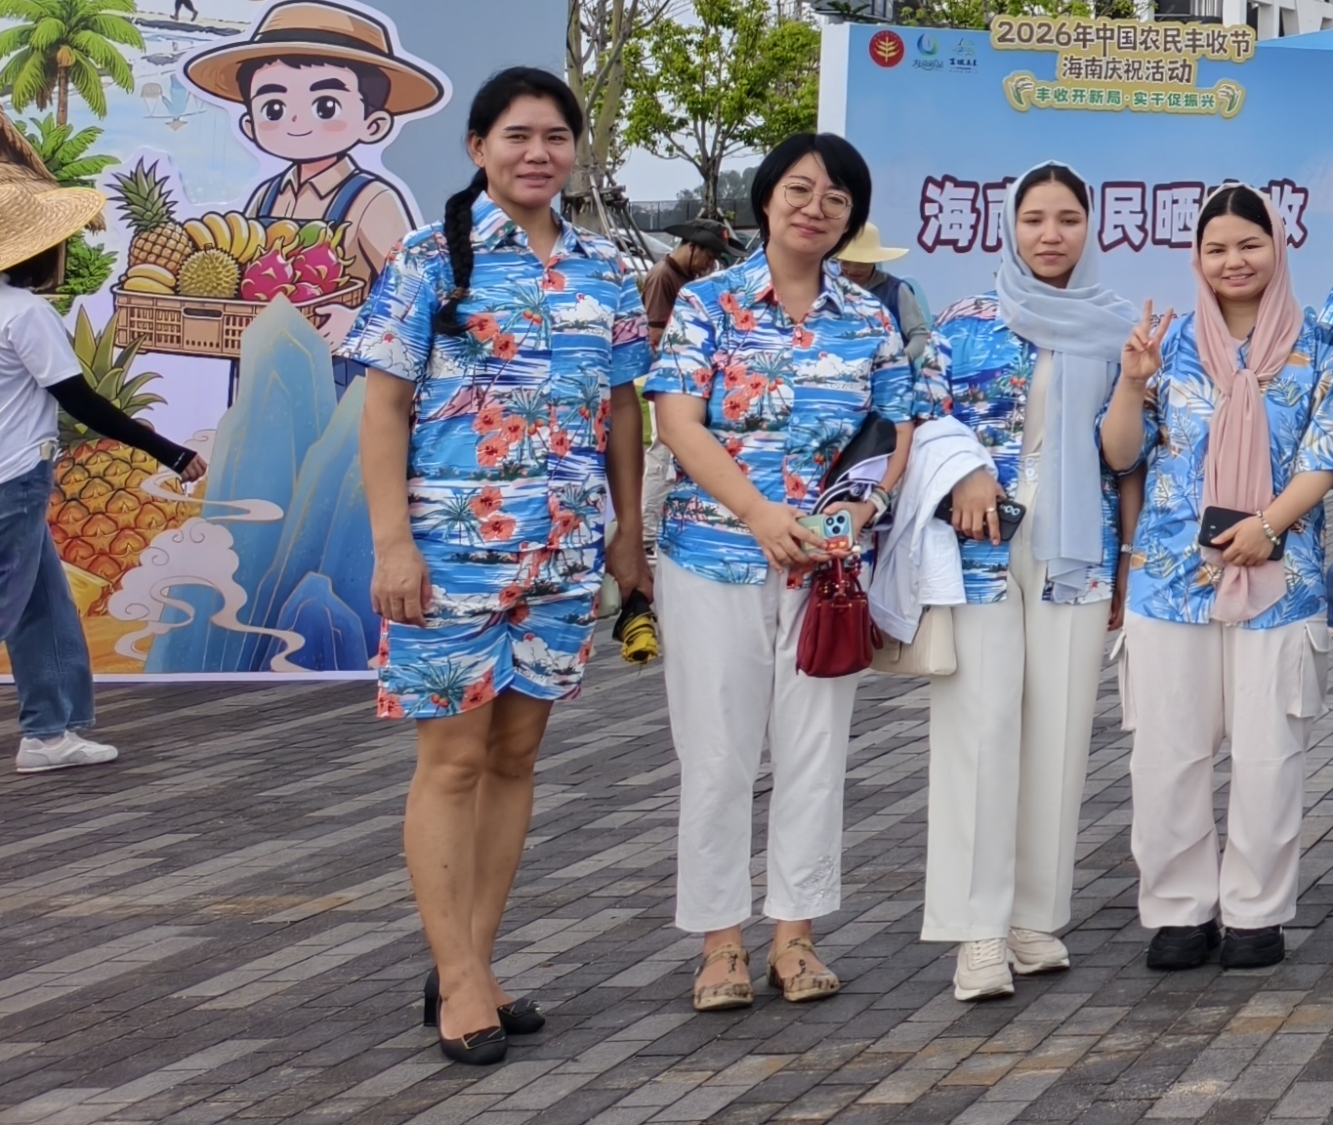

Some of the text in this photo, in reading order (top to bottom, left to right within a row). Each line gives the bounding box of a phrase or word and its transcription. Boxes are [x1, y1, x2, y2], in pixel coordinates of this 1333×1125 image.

[997, 21, 1251, 58] 2026年中国农民丰收节
[1062, 55, 1193, 84] 海南庆祝活动
